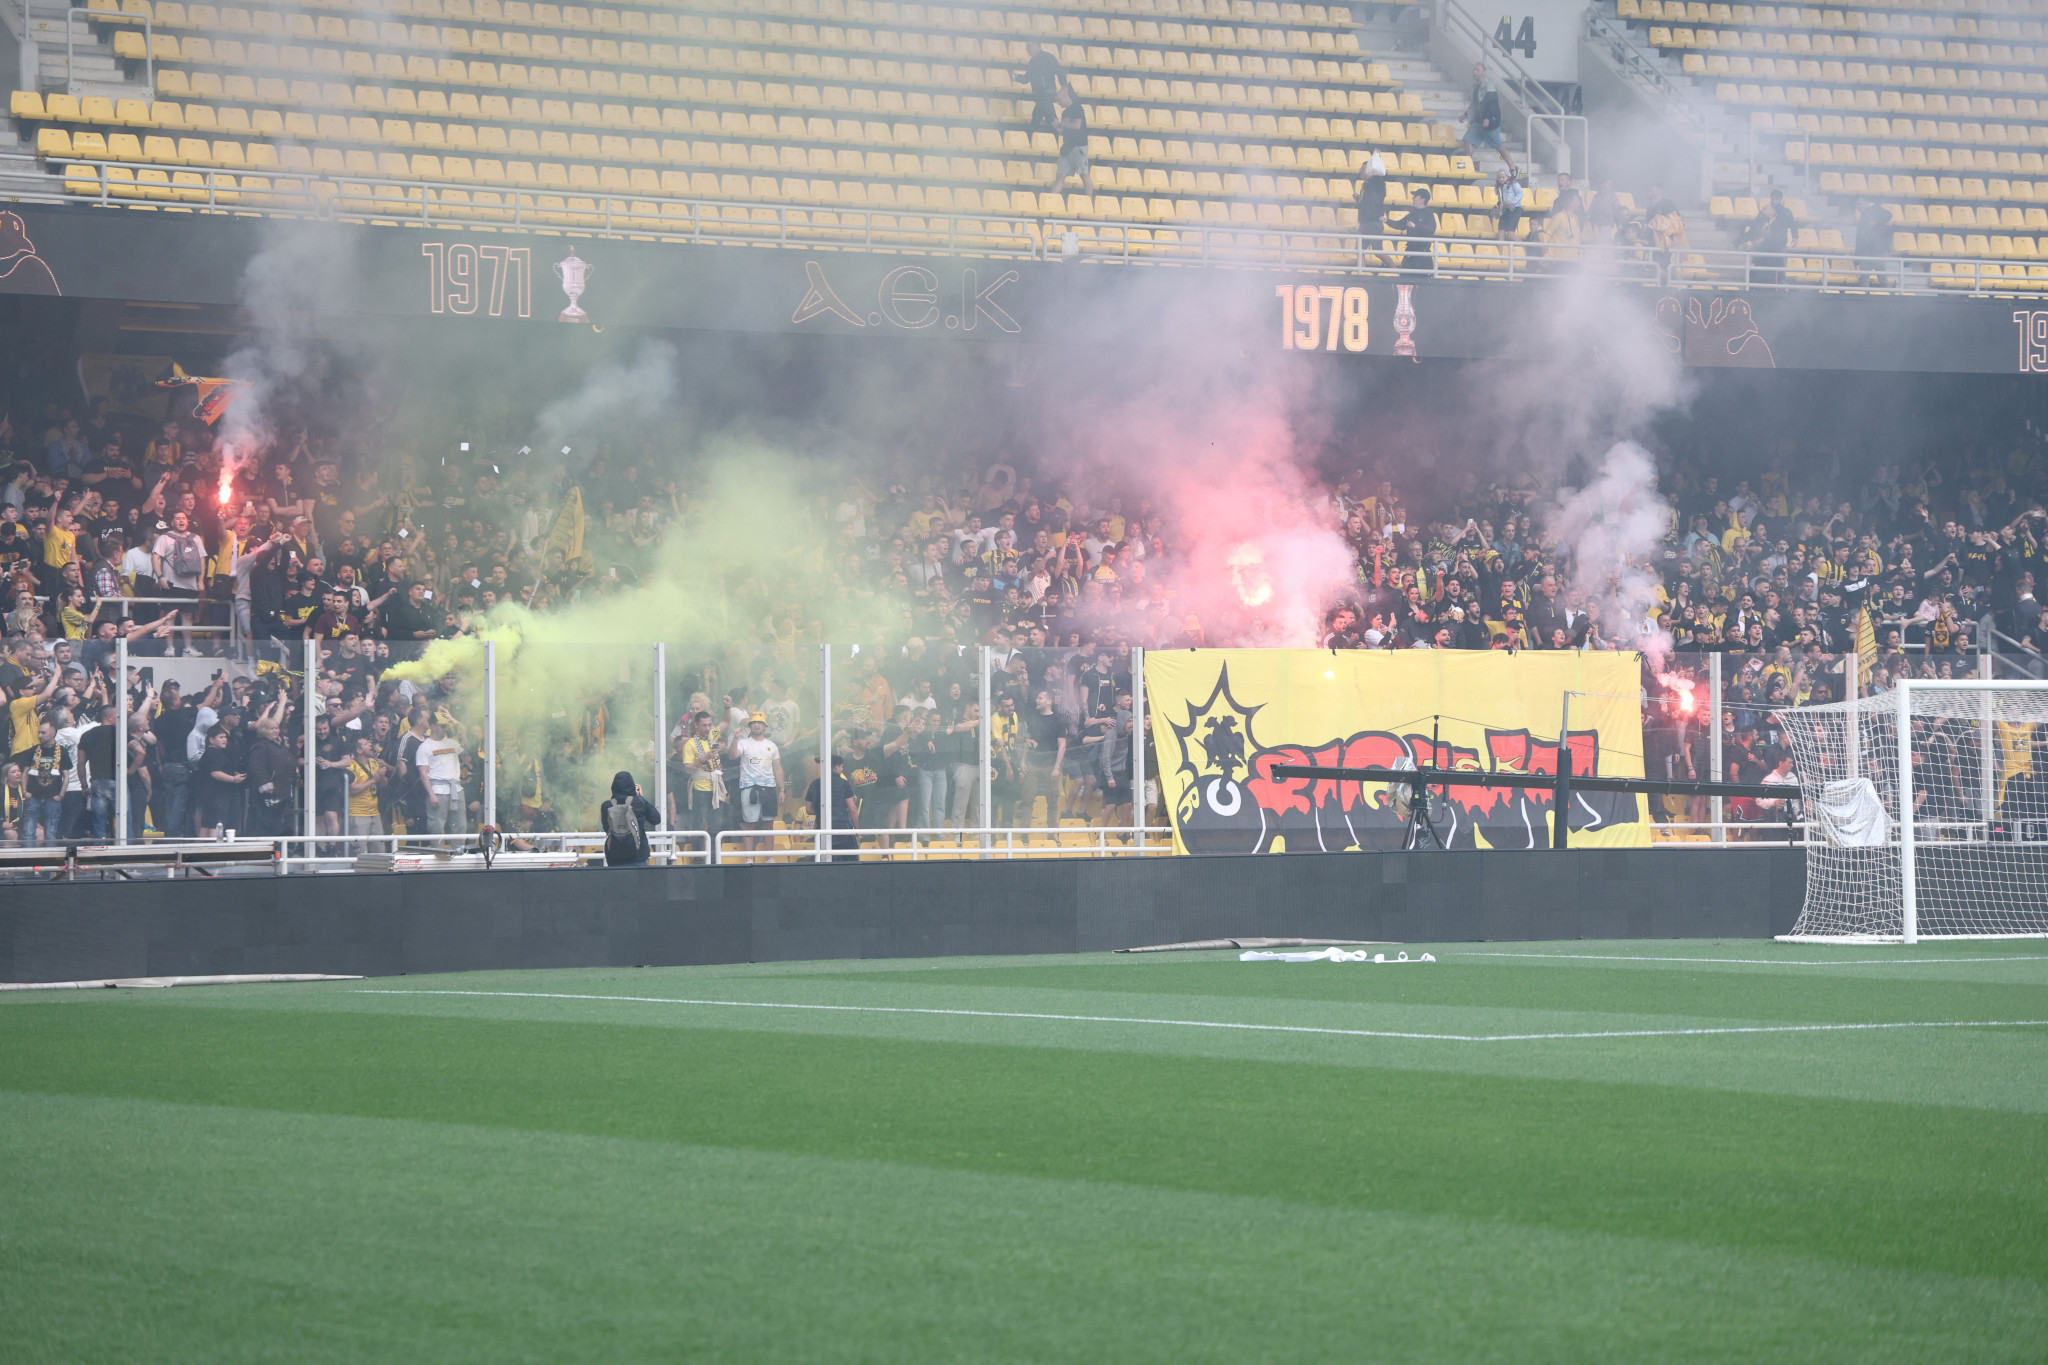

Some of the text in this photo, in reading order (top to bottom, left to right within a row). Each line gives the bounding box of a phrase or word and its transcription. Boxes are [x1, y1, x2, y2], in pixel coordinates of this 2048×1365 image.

[1492, 15, 1537, 59] 44
[422, 242, 532, 318] 1971
[1275, 284, 1369, 352] 1978
[2012, 310, 2048, 373] 19
